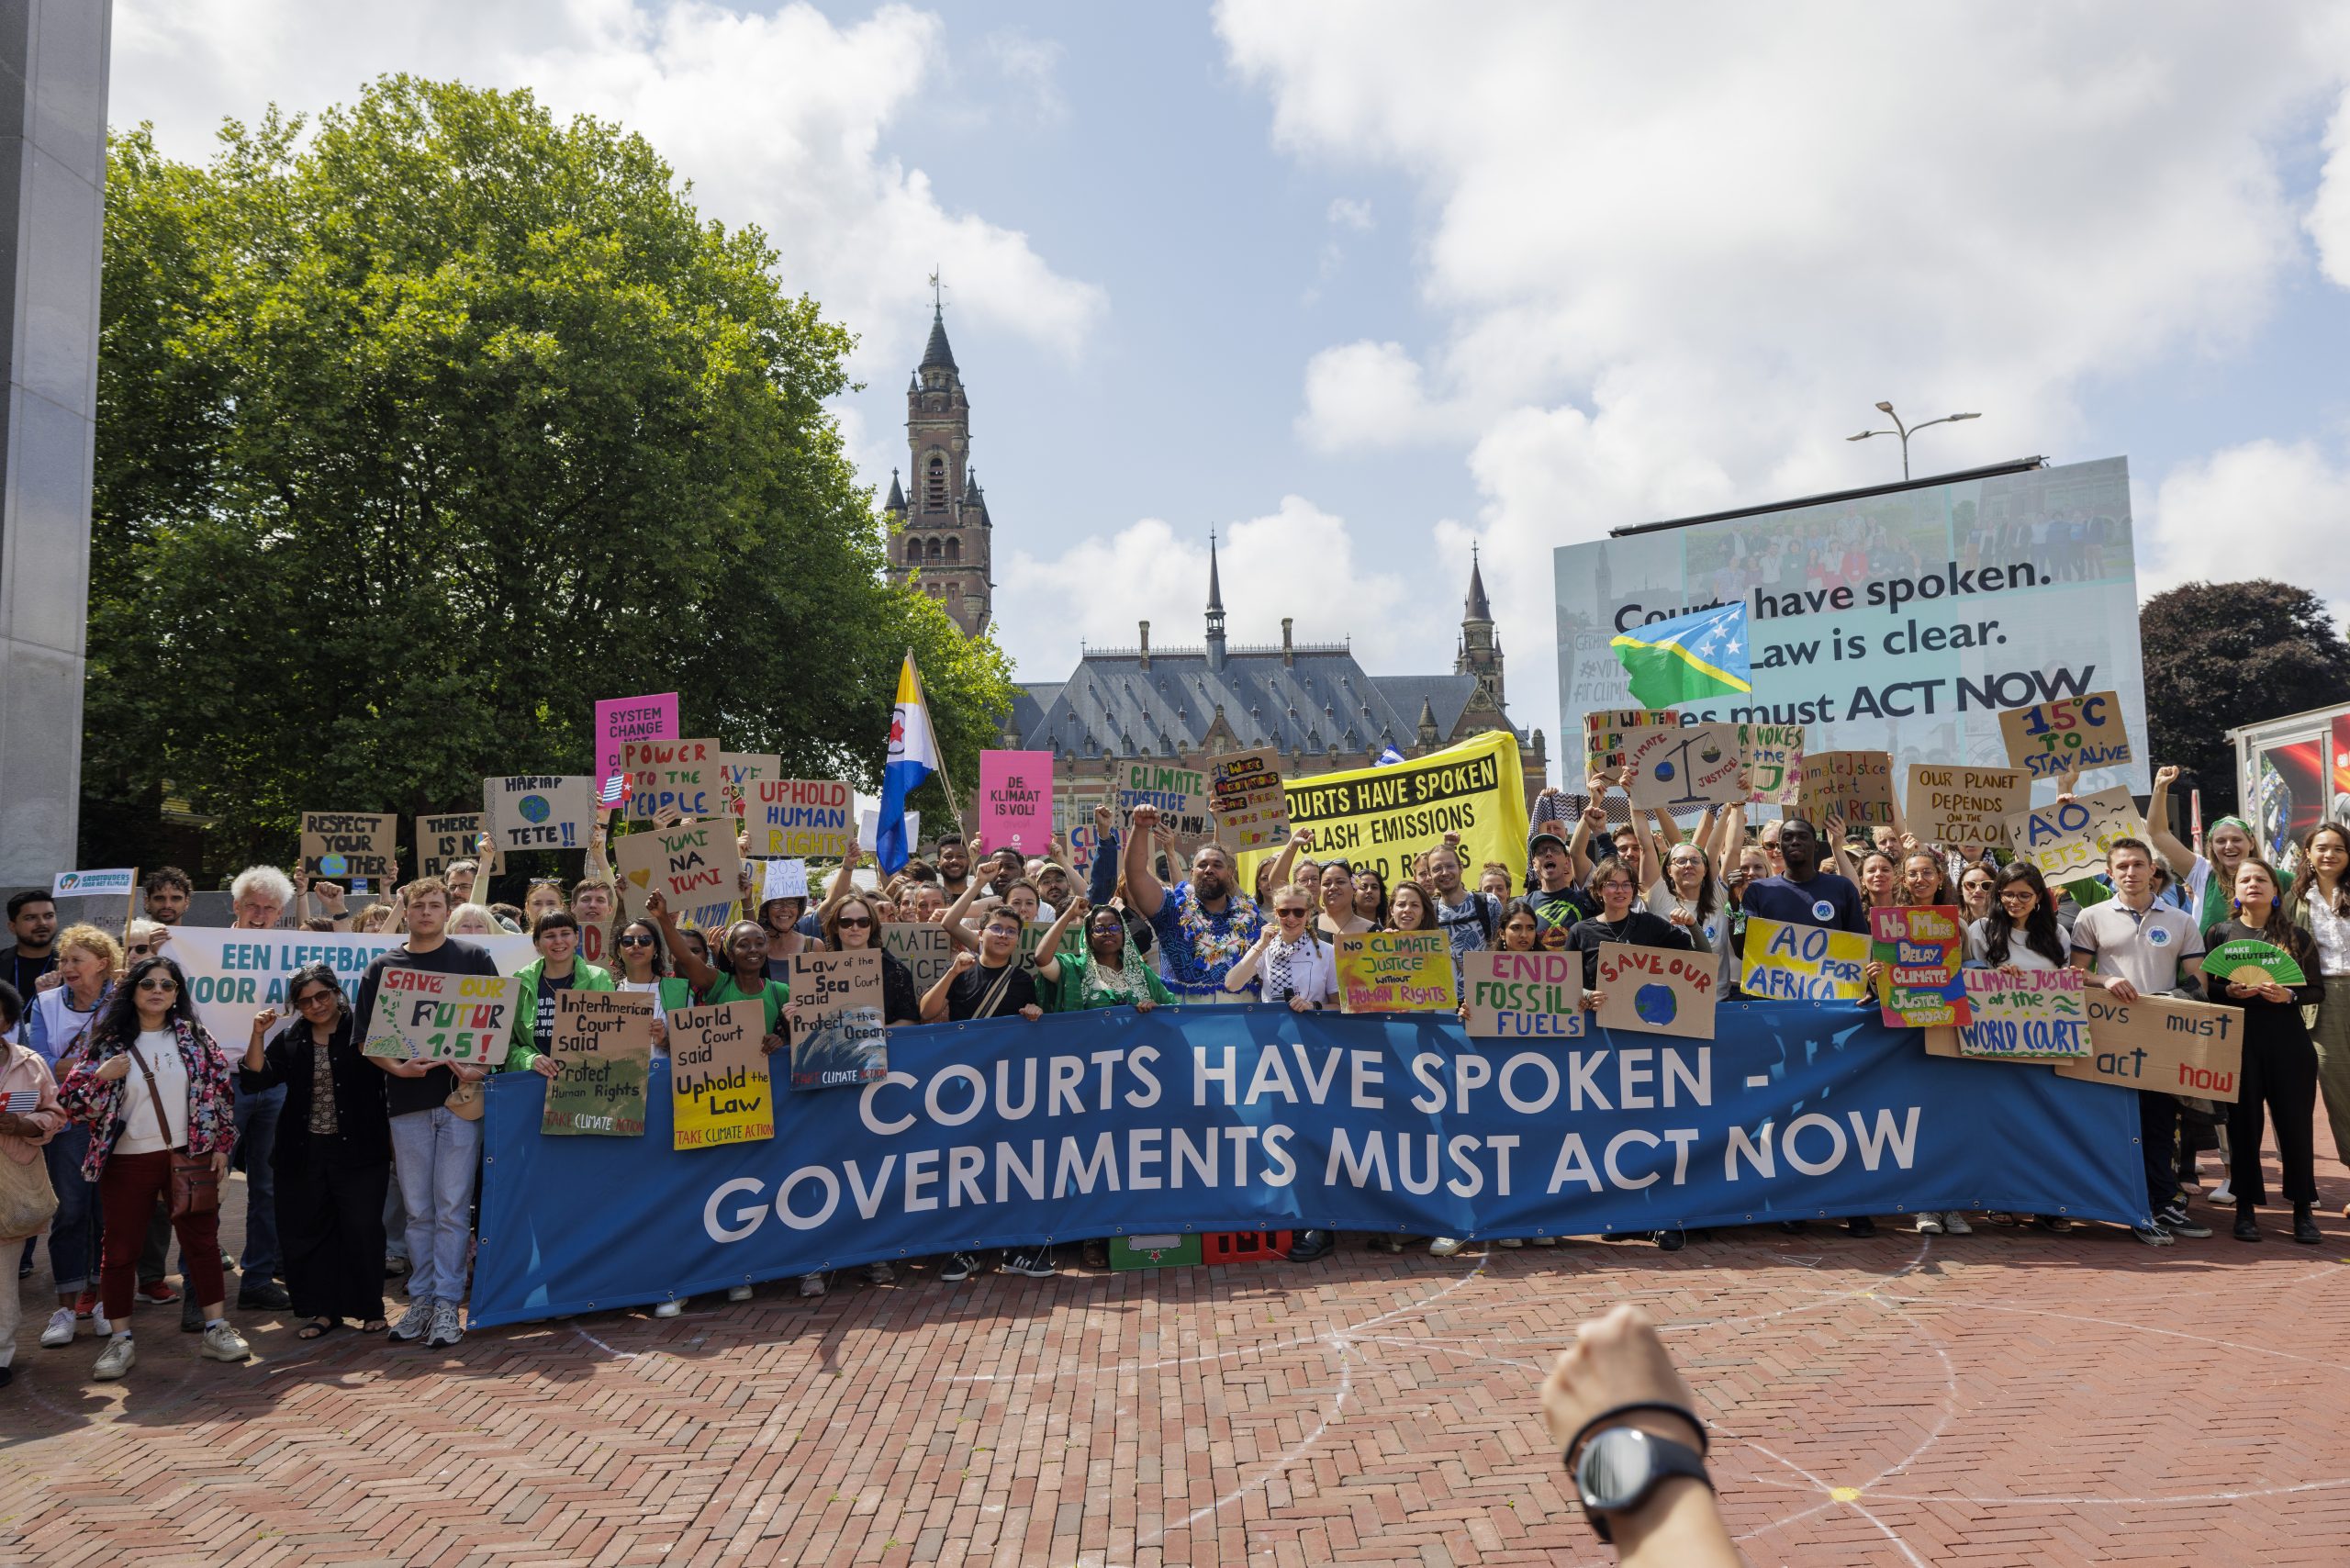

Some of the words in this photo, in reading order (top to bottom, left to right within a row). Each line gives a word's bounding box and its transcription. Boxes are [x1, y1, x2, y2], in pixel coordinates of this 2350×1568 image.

[1754, 586, 1854, 620] have
[1866, 561, 2052, 614] spoken.
[1832, 627, 1867, 661] is
[1883, 619, 2007, 655] clear.
[1730, 693, 1835, 724] must
[1845, 678, 1946, 722] ACT
[1955, 665, 2096, 712] NOW
[610, 707, 662, 724] SYSTEM
[610, 721, 663, 738] CHANGE
[2038, 732, 2082, 752] TO
[624, 744, 707, 768] POWER
[1629, 733, 1668, 777] CLIMATE
[2023, 752, 2073, 777] STAY
[636, 771, 657, 786] TO
[665, 770, 701, 784] THE
[1008, 777, 1024, 789] DE
[1697, 756, 1739, 788] JUSTICE!
[1919, 769, 1953, 787] OUR
[1964, 771, 2020, 790] PLANET
[759, 782, 846, 807] UPHOLD
[990, 790, 1041, 802] KLIMAAT
[1285, 788, 1350, 820] OURTS
[1357, 778, 1413, 810] HAVE
[1416, 759, 1495, 801] SPOKEN
[624, 791, 710, 817] PEOPLE
[995, 804, 1006, 815] IS
[1009, 804, 1035, 815] VOL!
[1120, 790, 1187, 812] JUSTICE
[1849, 800, 1895, 824] RIGHTS
[1931, 792, 2003, 812] DEPENDS
[307, 815, 382, 834] RESPECT
[426, 815, 479, 833] THERE
[767, 805, 845, 828] HUMAN
[1371, 802, 1475, 845] EMISSIONS
[1946, 813, 1965, 823] ON
[1966, 812, 1982, 823] THE
[2029, 803, 2090, 846] AO
[319, 834, 375, 852] YOUR
[438, 836, 457, 856] IS
[658, 829, 708, 854] YUMI
[1239, 829, 1270, 846] NOT
[669, 850, 705, 873] NA
[768, 860, 799, 876] SOS
[667, 868, 722, 895] YUMI
[885, 929, 949, 952] MATE
[1343, 940, 1364, 952] NO
[1371, 936, 1444, 953] CLIMATE
[1770, 924, 1829, 962] AO
[2224, 946, 2250, 955] MAKE
[221, 943, 272, 971] EEN
[280, 945, 387, 972] LEEFBA
[795, 955, 838, 974] Law
[844, 957, 855, 968] of
[857, 957, 874, 966] the
[2225, 951, 2276, 961] POLLUTERS
[2261, 957, 2281, 966] PAY
[1492, 954, 1568, 983] END
[1600, 952, 1664, 982] SAVE
[1669, 958, 1711, 994] OUR
[1820, 959, 1862, 982] FOR
[1892, 968, 1948, 984] CLIMATE
[384, 969, 446, 994] SAVE
[459, 977, 508, 999] OUR
[815, 974, 850, 993] Sea
[855, 973, 880, 988] Court
[1746, 966, 1835, 1000] AFRICA
[795, 991, 829, 1007] said
[1347, 985, 1393, 1006] HUMAN
[1988, 991, 2007, 1005] at
[2009, 991, 2044, 1008] the
[410, 1000, 505, 1029] FUTUR
[576, 1014, 626, 1033] Court
[674, 1005, 733, 1031] World
[793, 1009, 845, 1033] Protect
[856, 1012, 877, 1023] the
[1497, 1011, 1580, 1036] FUELS
[1907, 1009, 1952, 1024] TODAY
[701, 1025, 744, 1045] Court
[845, 1025, 886, 1040] Ocean
[1959, 1019, 2018, 1052] WORLD
[2022, 1019, 2088, 1052] COURT
[2165, 1013, 2233, 1040] must
[558, 1031, 599, 1052] said
[677, 1043, 712, 1066] said
[553, 1058, 611, 1082] Protect
[822, 1070, 857, 1084] CLIMATE
[2096, 1047, 2149, 1079] act
[2178, 1062, 2233, 1093] now
[551, 1084, 587, 1099] Human
[594, 1081, 640, 1103] Rights
[677, 1064, 746, 1103] Uphold
[751, 1071, 768, 1083] the
[859, 1045, 1163, 1136] COURTS
[1193, 1043, 1384, 1110] HAVE
[1411, 1046, 1712, 1114] SPOKEN
[710, 1095, 762, 1115] Law
[545, 1111, 573, 1128] TAKE
[575, 1113, 613, 1131] CLIMATE
[615, 1118, 643, 1132] ACTION
[676, 1129, 702, 1145] TAKE
[705, 1125, 743, 1143] CLIMATE
[744, 1123, 774, 1139] ACTION
[703, 1123, 1297, 1243] GOVERNMENTS
[1324, 1127, 1521, 1198] MUST
[1546, 1128, 1700, 1194] ACT
[1724, 1106, 1922, 1182] NOW
